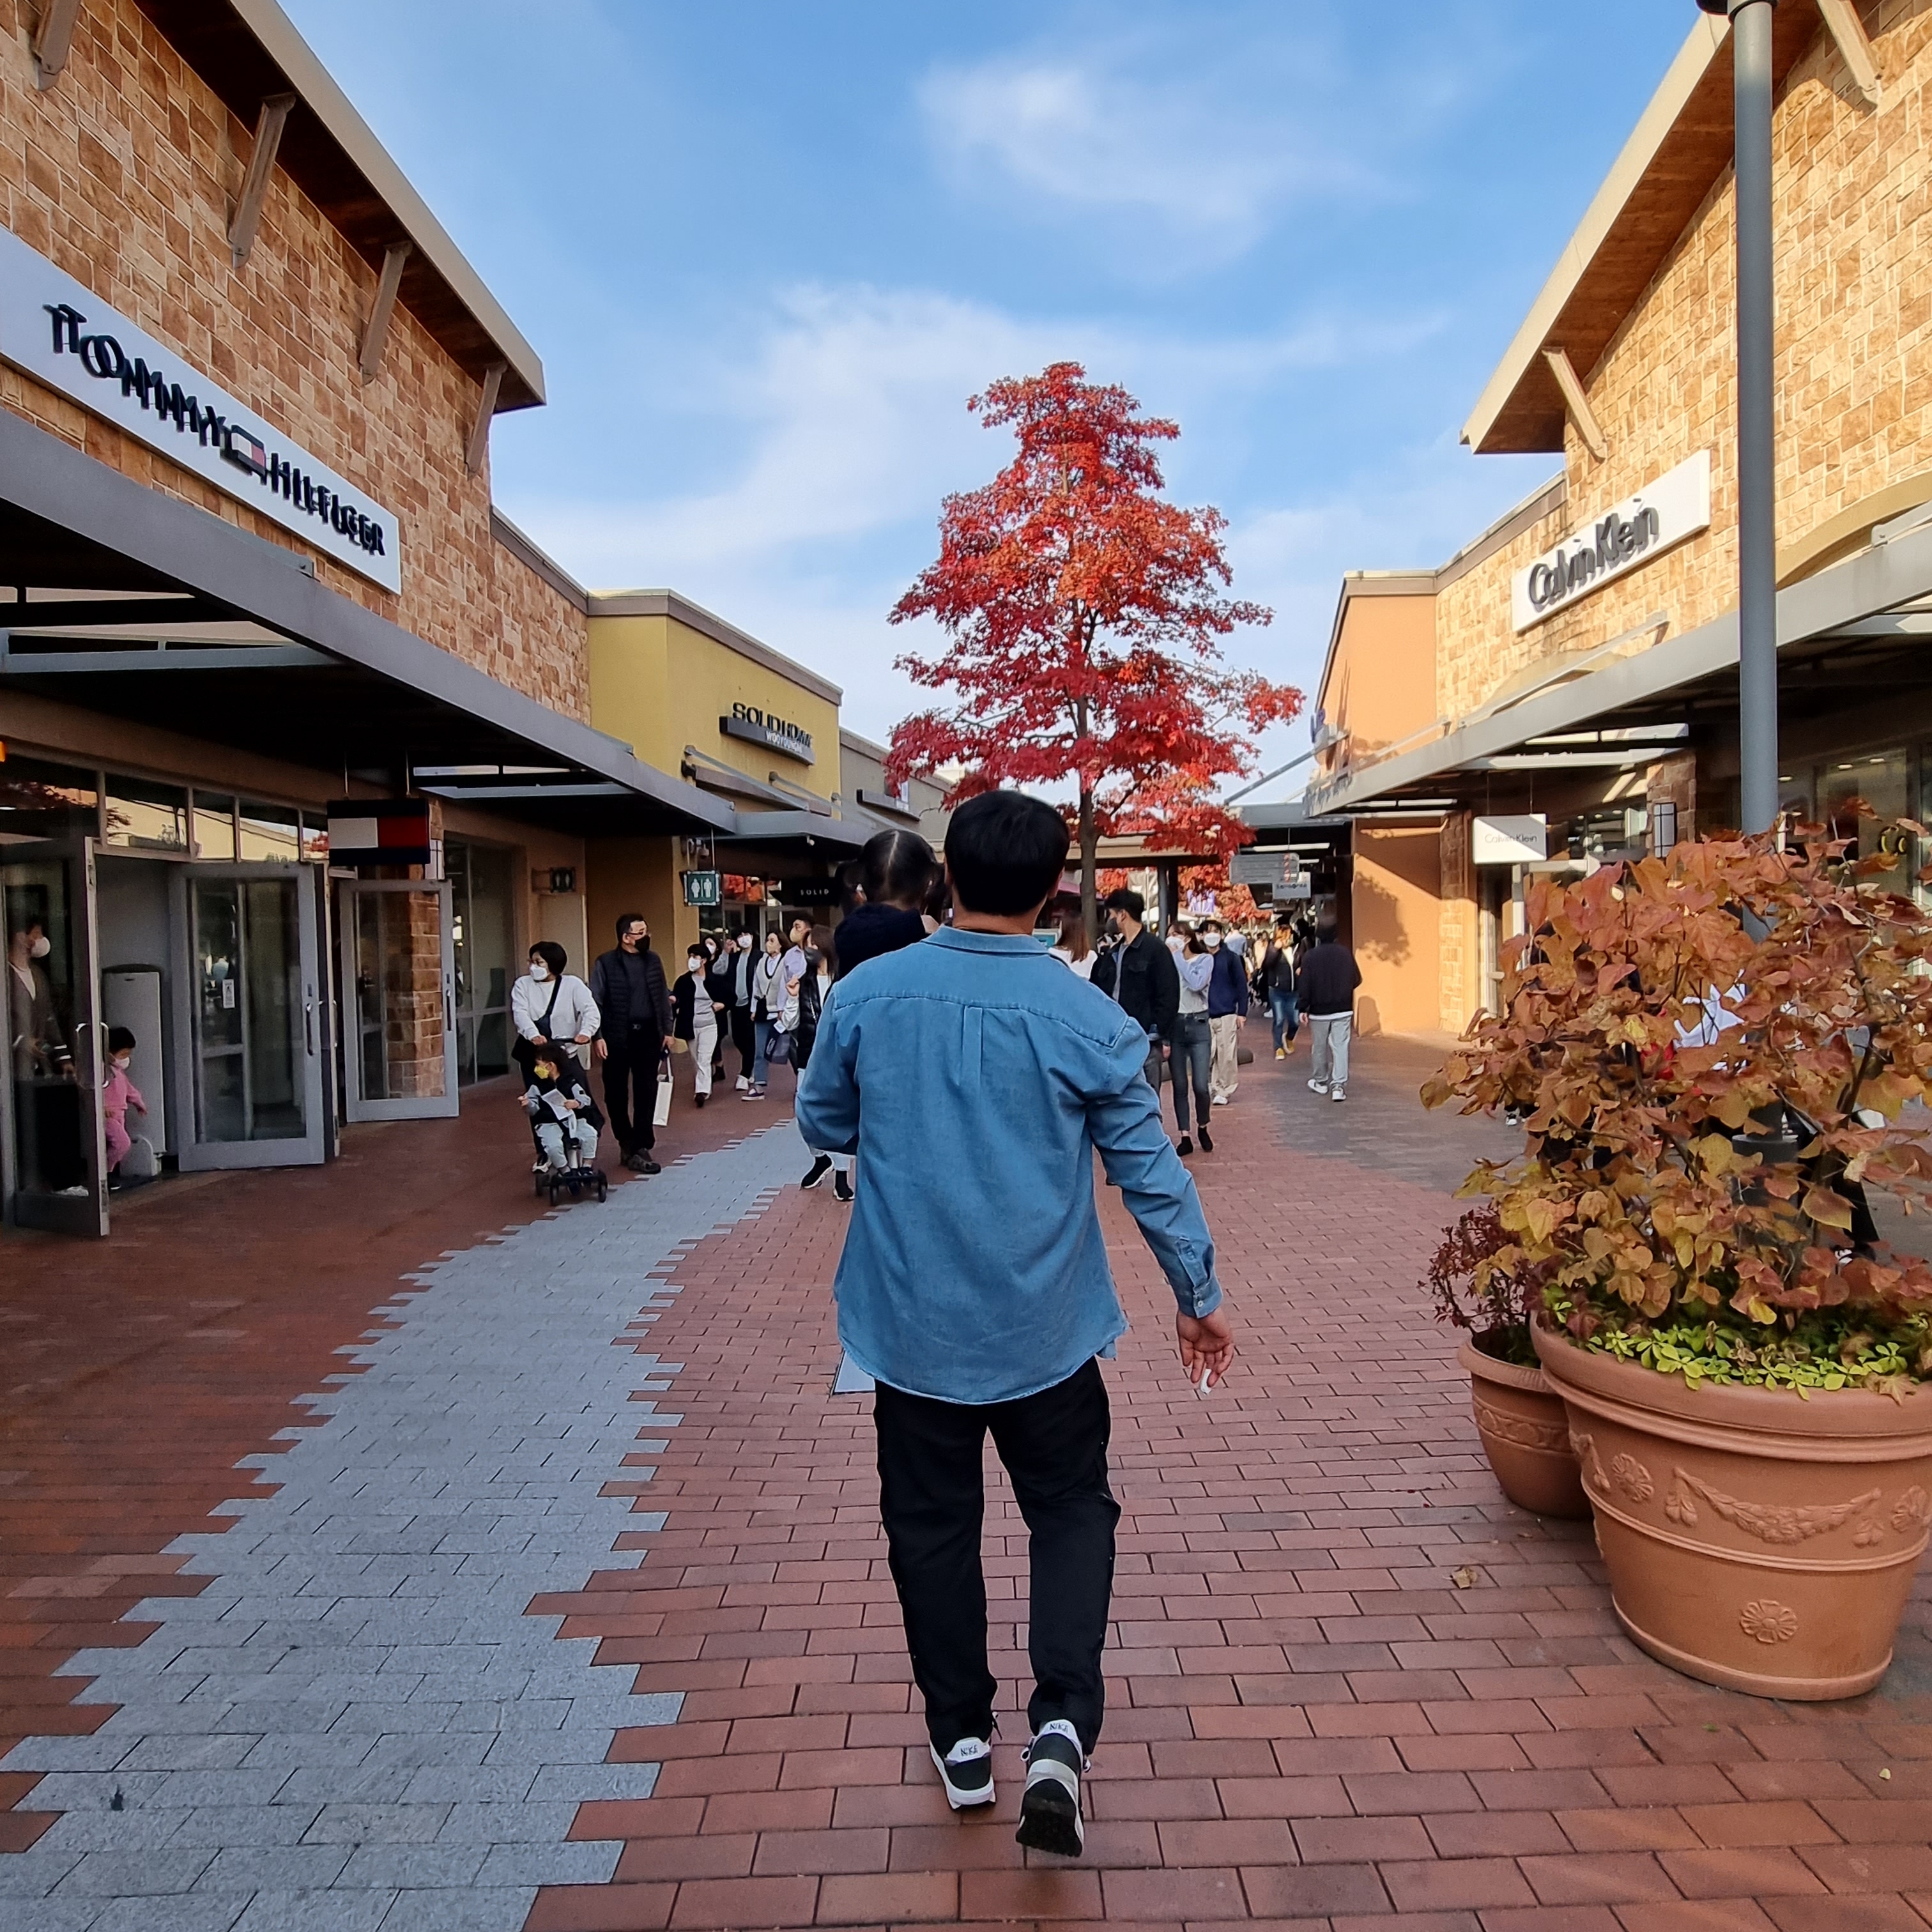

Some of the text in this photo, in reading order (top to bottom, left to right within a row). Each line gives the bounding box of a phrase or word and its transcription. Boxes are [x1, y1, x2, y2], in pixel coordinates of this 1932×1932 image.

[43, 303, 386, 556] TOMMY HILFIGER
[1529, 498, 1659, 604] Calvin Klein
[1485, 833, 1537, 843] Calvin Klein
[800, 888, 829, 896] SOLID
